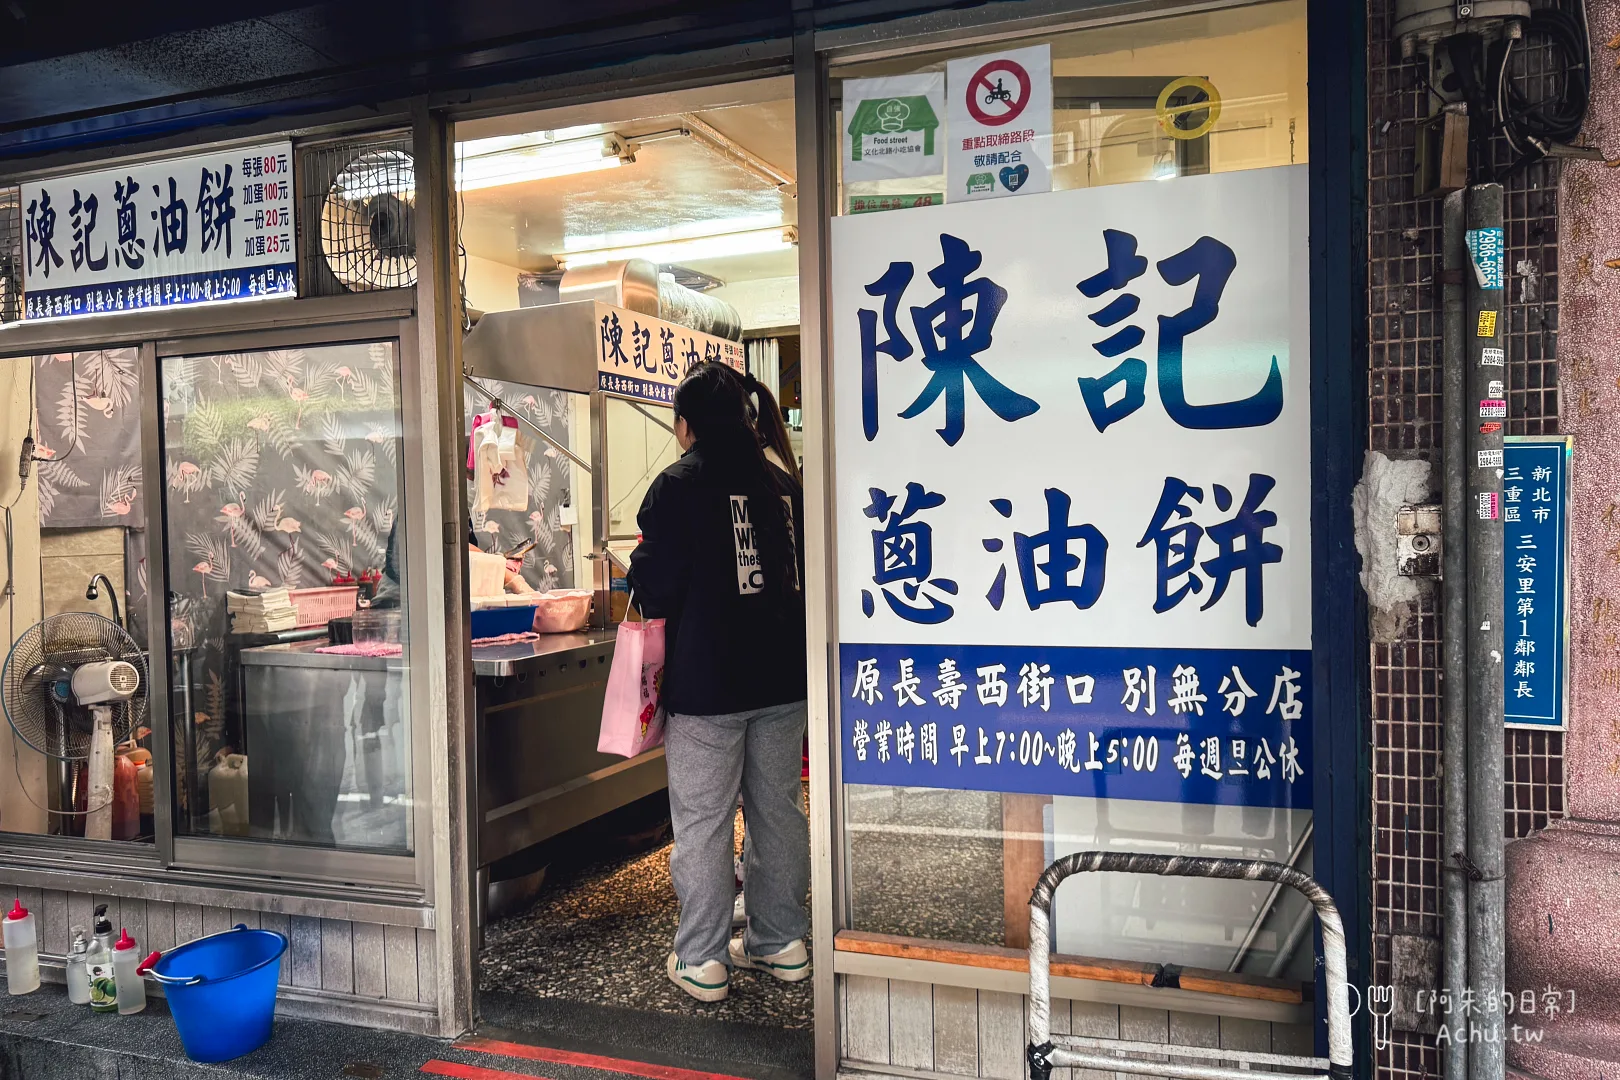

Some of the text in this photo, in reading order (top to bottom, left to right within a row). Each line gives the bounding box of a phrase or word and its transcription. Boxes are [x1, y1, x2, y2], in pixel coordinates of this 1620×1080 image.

[873, 136, 908, 145] Food street
[961, 128, 1035, 151] 重點取締路段
[973, 149, 1023, 168] 敬請配合
[242, 154, 288, 178] 每張80元
[242, 180, 289, 206] 加蛋100元
[25, 163, 237, 280] 陳記蔥油餅
[243, 206, 290, 231] 一份20元
[244, 233, 290, 258] 加蛋25元
[26, 296, 81, 319] 原長壽西街口
[86, 288, 124, 312] 別無分店
[127, 284, 161, 309] 營業時間
[857, 229, 1285, 447] 陳記
[1503, 466, 1524, 523] 三重區
[1532, 465, 1552, 524] 新北市
[861, 472, 1285, 628] 蔥油餅
[1513, 534, 1538, 699] 三安里第1鄰鄰長
[851, 657, 1304, 722] 原長壽西街口 別無分店
[852, 718, 939, 766] 營業時間
[949, 722, 1160, 775] 早上7:00~晚上5:00
